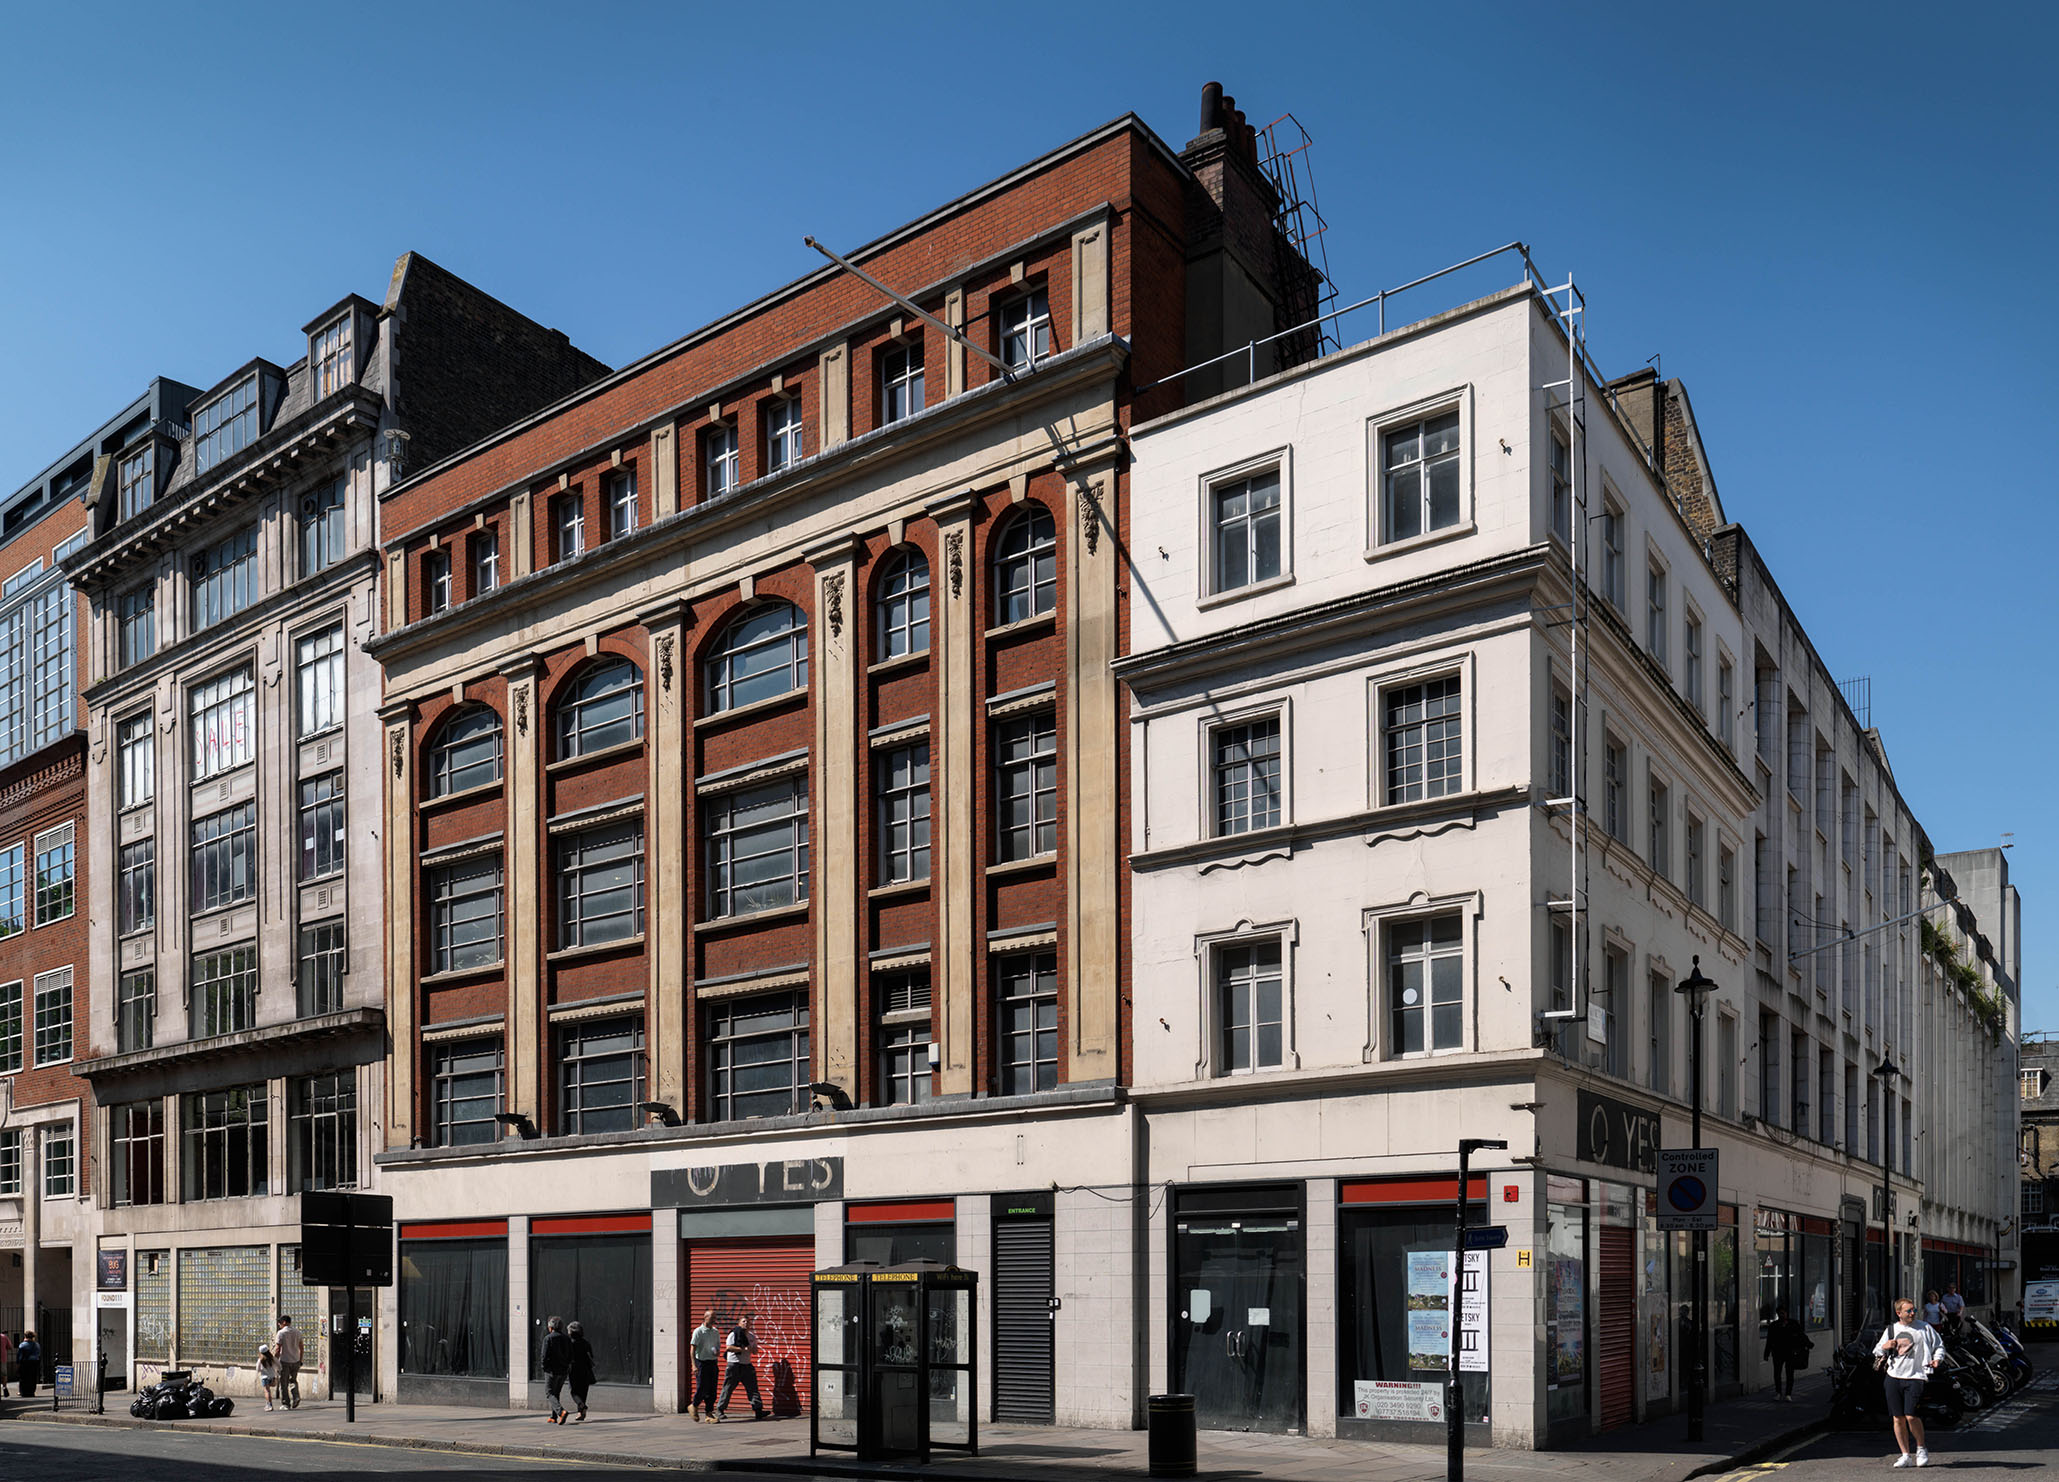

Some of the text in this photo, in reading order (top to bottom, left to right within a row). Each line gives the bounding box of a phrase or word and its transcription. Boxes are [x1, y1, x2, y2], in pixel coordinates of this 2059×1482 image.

[195, 710, 244, 764] SALE
[1662, 1152, 1714, 1161] Controlled
[1669, 1163, 1706, 1173] ZONE
[1518, 1251, 1530, 1266] H
[817, 1274, 857, 1282] TELEPHONE
[874, 1273, 915, 1281] TELEPHONE
